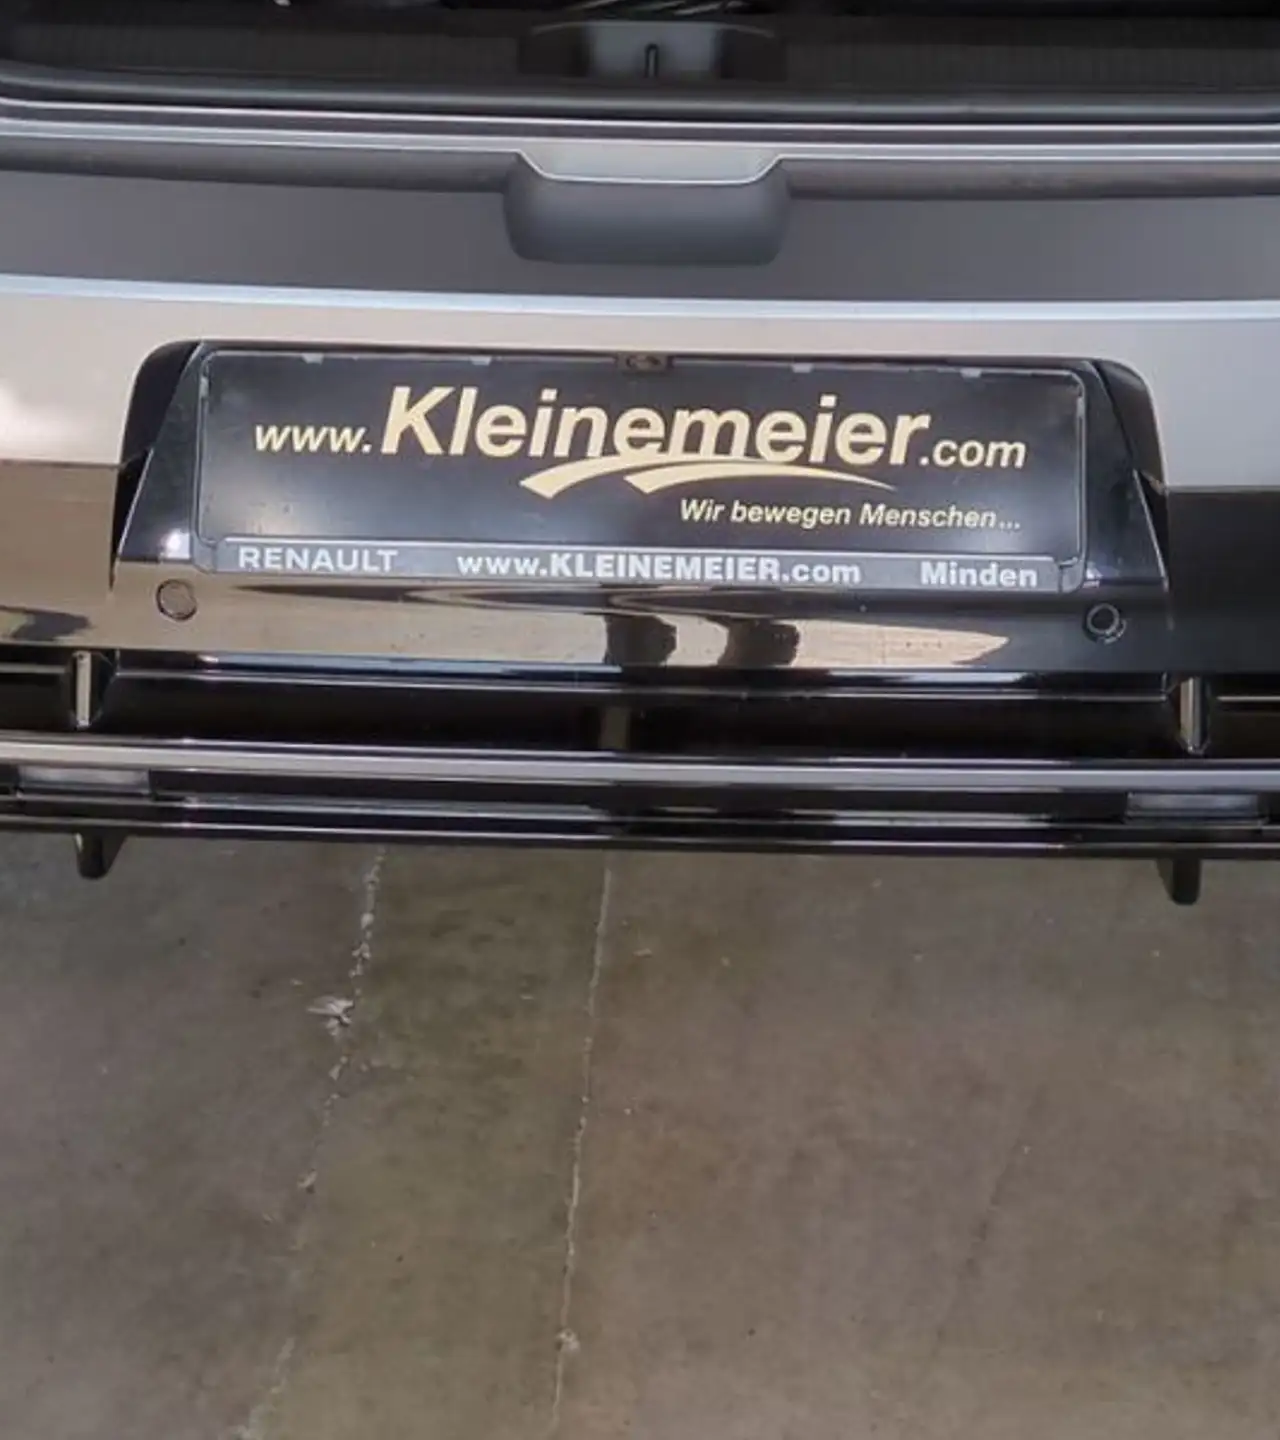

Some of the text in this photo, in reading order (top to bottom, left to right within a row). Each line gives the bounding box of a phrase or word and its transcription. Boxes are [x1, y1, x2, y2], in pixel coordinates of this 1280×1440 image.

[254, 385, 1027, 469] www.Kleinemeier.com
[680, 498, 1021, 530] Wir bewegen Menschen...
[238, 545, 1039, 589] RENAULT www.KLEINEMEIER.com Minden
